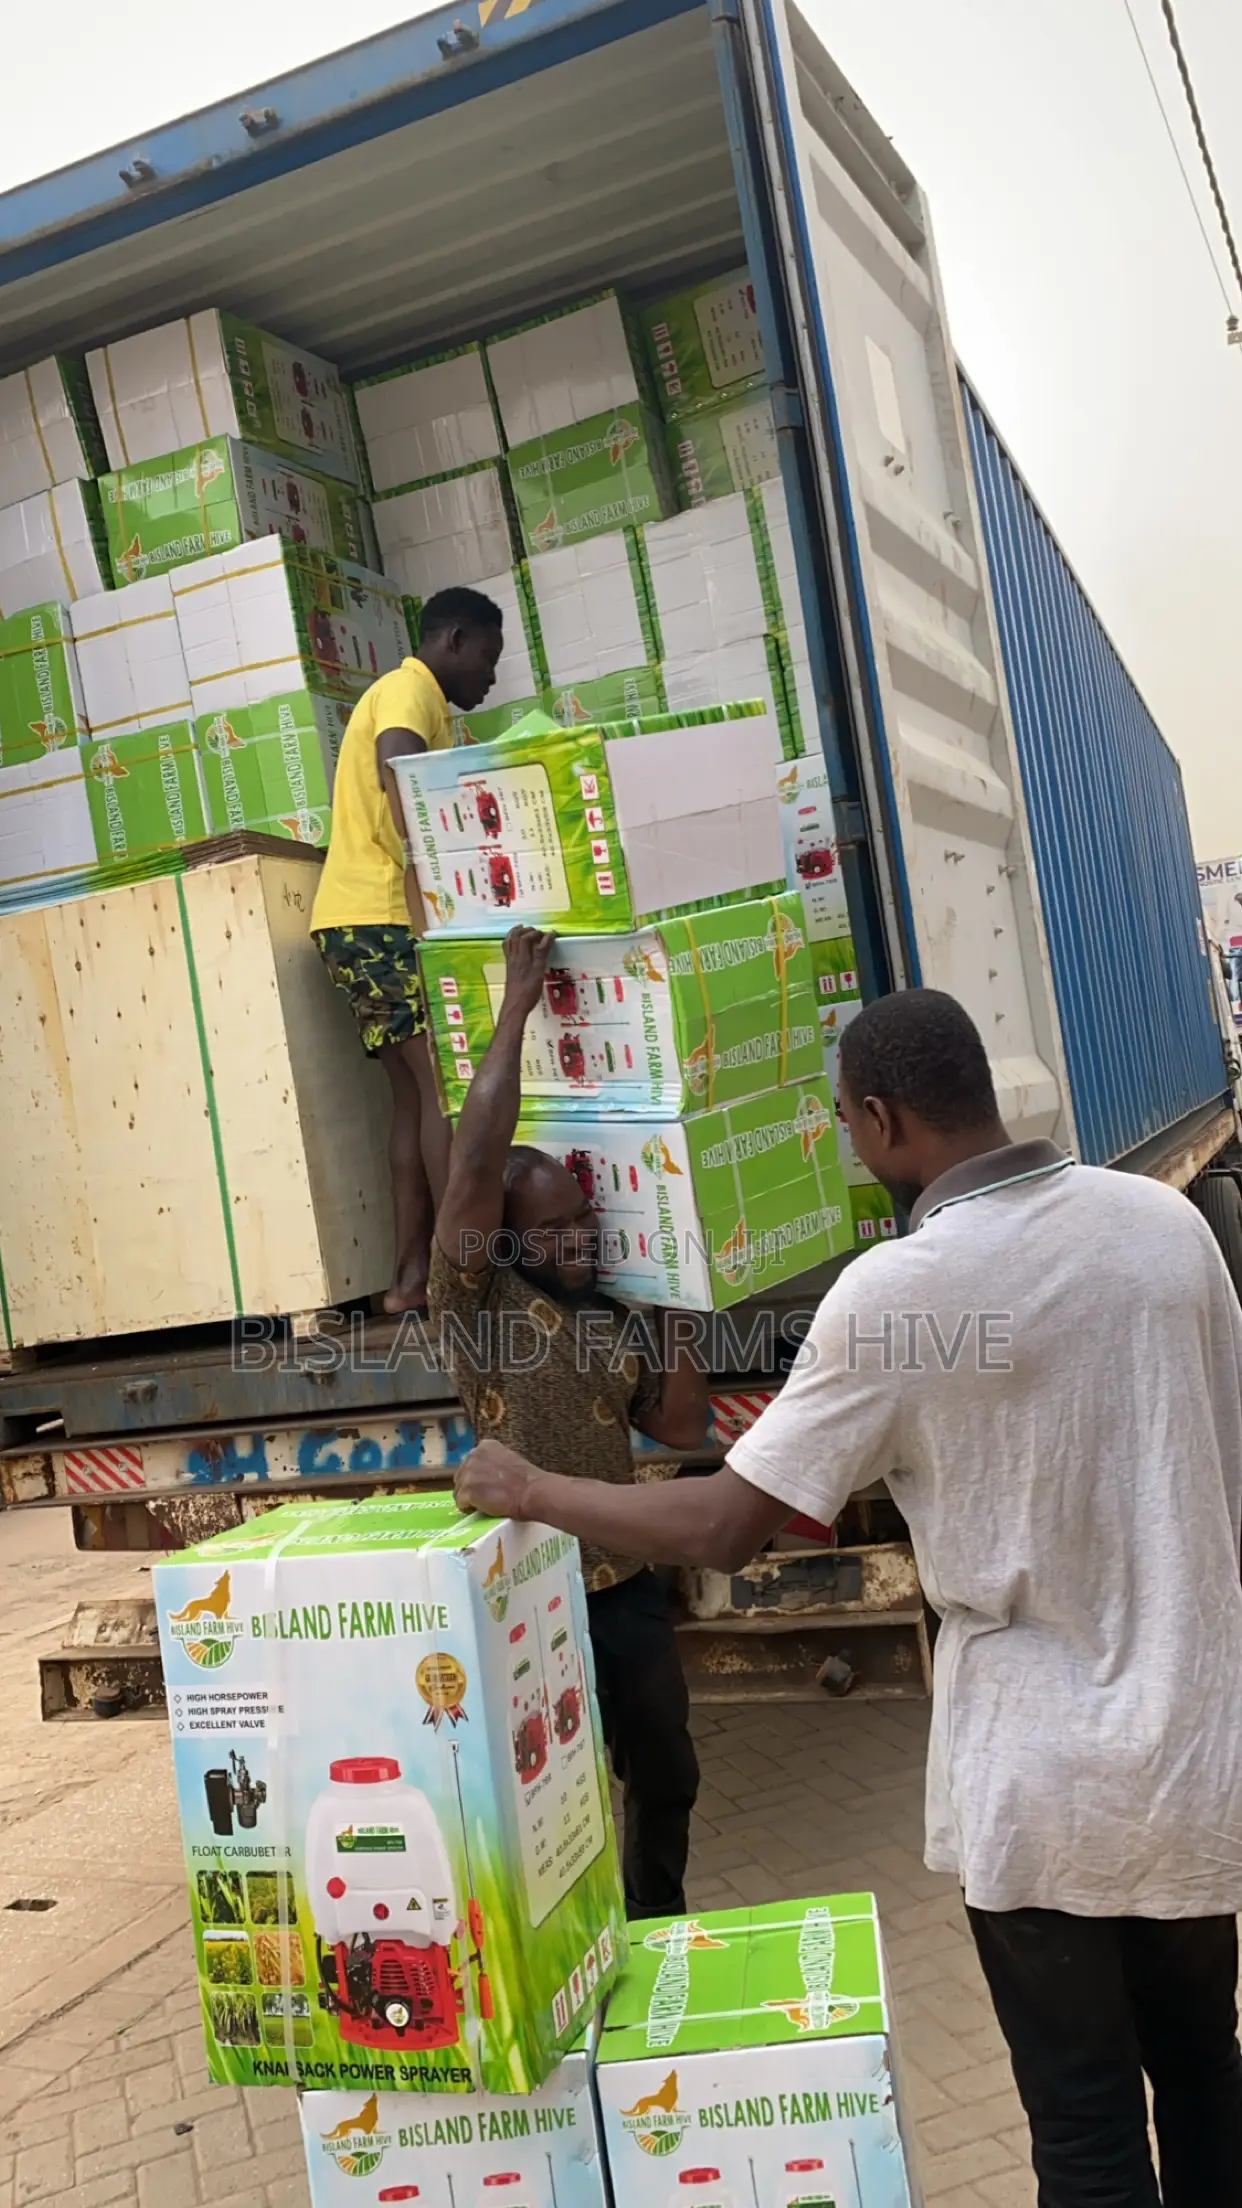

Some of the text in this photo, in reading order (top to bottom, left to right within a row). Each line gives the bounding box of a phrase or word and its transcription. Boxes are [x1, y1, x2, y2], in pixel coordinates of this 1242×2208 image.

[33, 642, 48, 670] FAR
[227, 803, 245, 830] FAR
[415, 801, 432, 832] FARM
[641, 993, 658, 1043] BISLAND
[722, 1026, 815, 1069] BISLAND FAR HIVE
[646, 1046, 664, 1080] FARM
[755, 1120, 793, 1153] BISLAND
[701, 1143, 727, 1168] HIVE
[794, 1211, 820, 1243] FARM
[820, 1206, 841, 1229] HIVE
[657, 1184, 675, 1234] BISLAND
[667, 1273, 681, 1300] HIVE
[171, 1621, 244, 1636] BISLAND FARM HIVE
[251, 1601, 449, 1641] BILAND FARM HIVE
[186, 1692, 268, 1702] HIGH HORSEPOWER
[188, 1705, 284, 1716] HIGH SPRAY PRESSE
[189, 1720, 265, 1729] EXCELLENT VALVE
[192, 1846, 291, 1857] FLOAT CARBUBETR
[253, 2061, 472, 2083] KNASACK POWER SPRAYER
[622, 2114, 692, 2130] BISLAND FARM HIVE
[698, 2091, 880, 2129] BISLAND FARM HIVE
[398, 2107, 576, 2148] BISLAND FARM HIVE
[322, 2135, 392, 2153] BISLAND FARM HIVE
